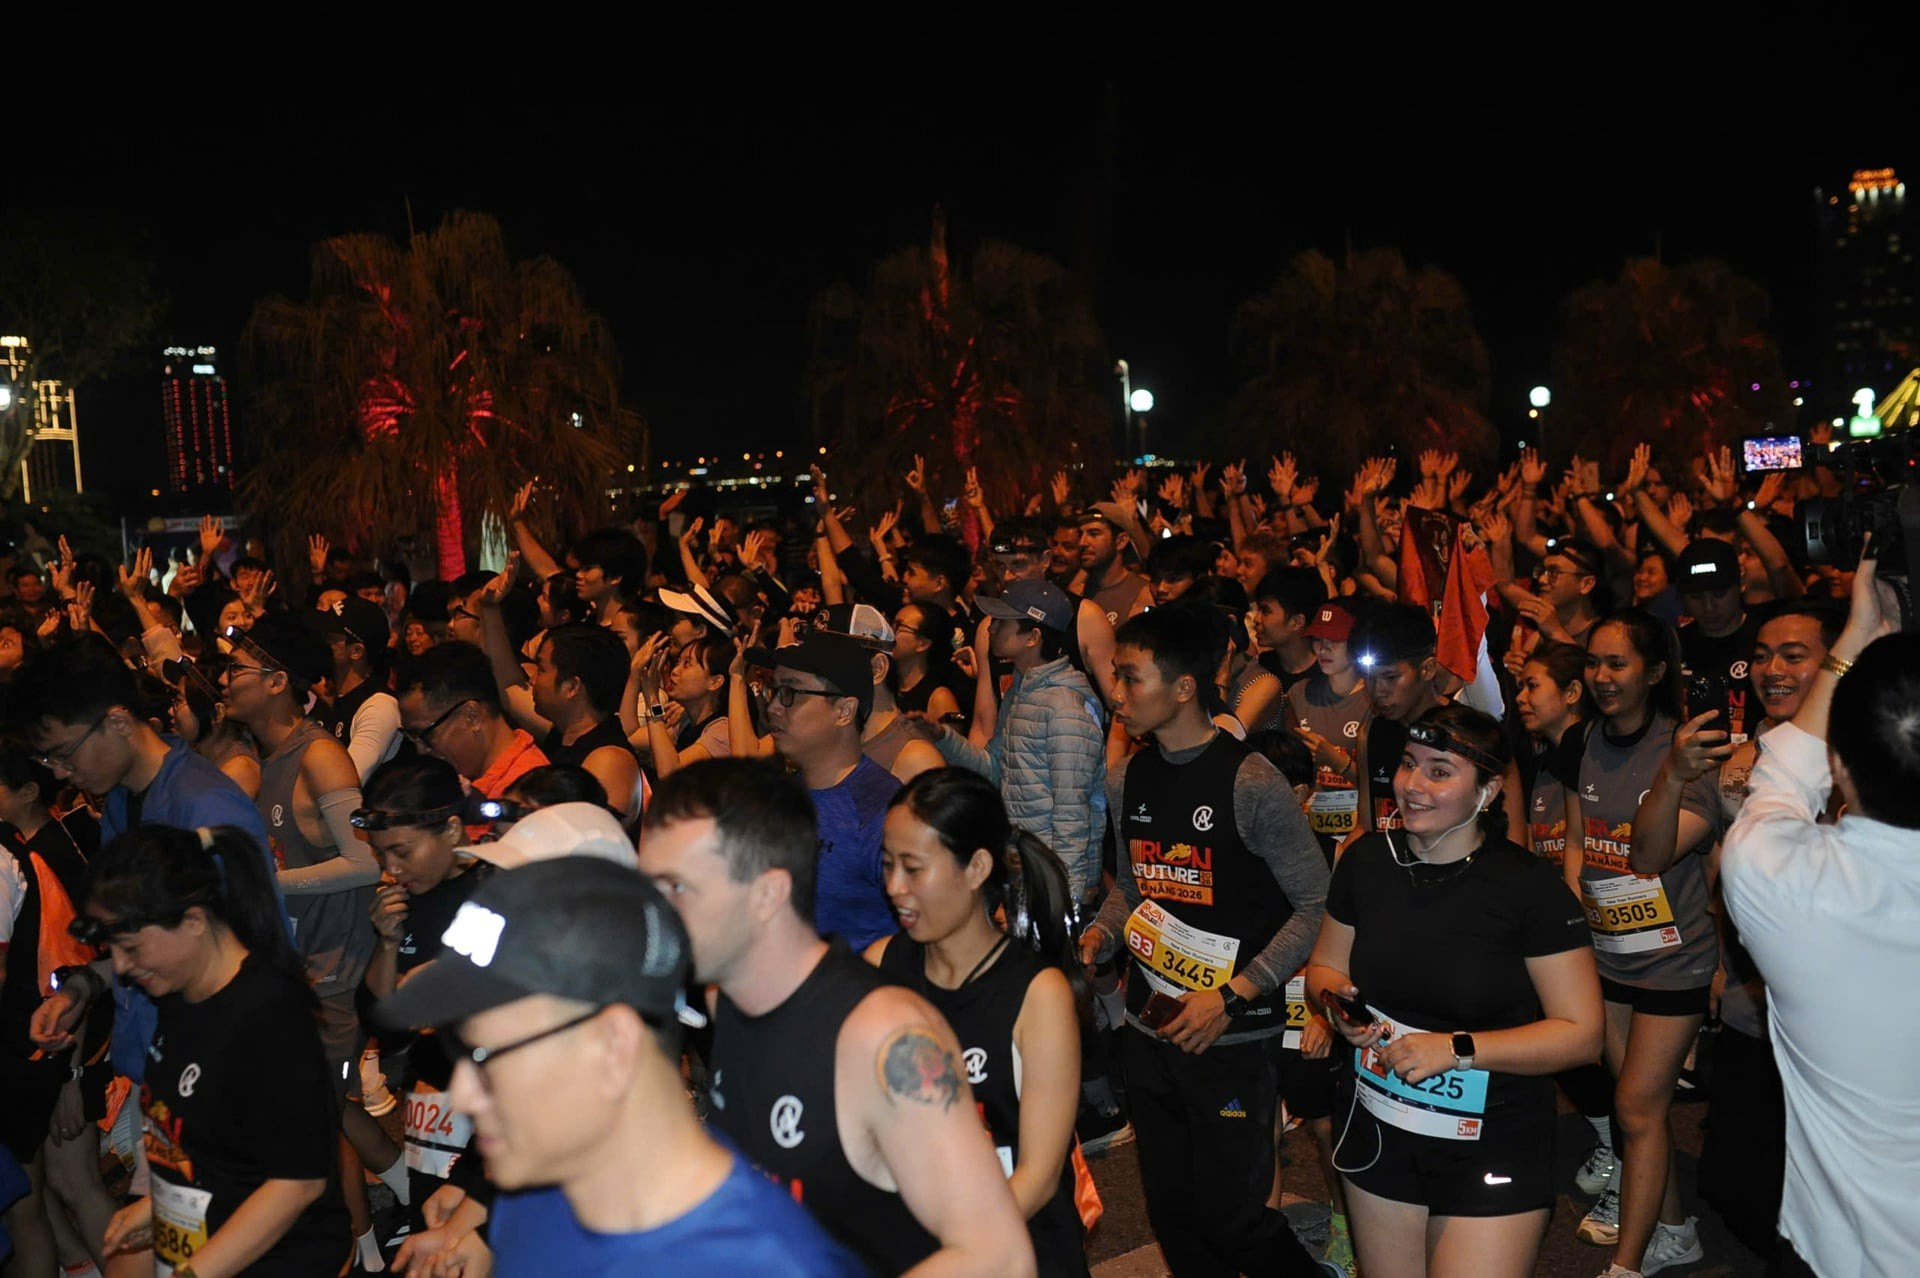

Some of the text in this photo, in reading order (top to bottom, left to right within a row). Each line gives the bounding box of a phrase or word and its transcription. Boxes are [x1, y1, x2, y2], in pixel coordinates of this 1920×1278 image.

[1315, 813, 1353, 828] 3438
[1141, 839, 1212, 870] RUN
[1178, 888, 1203, 900] 2026
[1606, 901, 1658, 926] 3505
[1128, 929, 1154, 958] B3
[1162, 950, 1216, 988] 3445
[1219, 1109, 1247, 1119] adidas
[1458, 1119, 1478, 1136] 5KM
